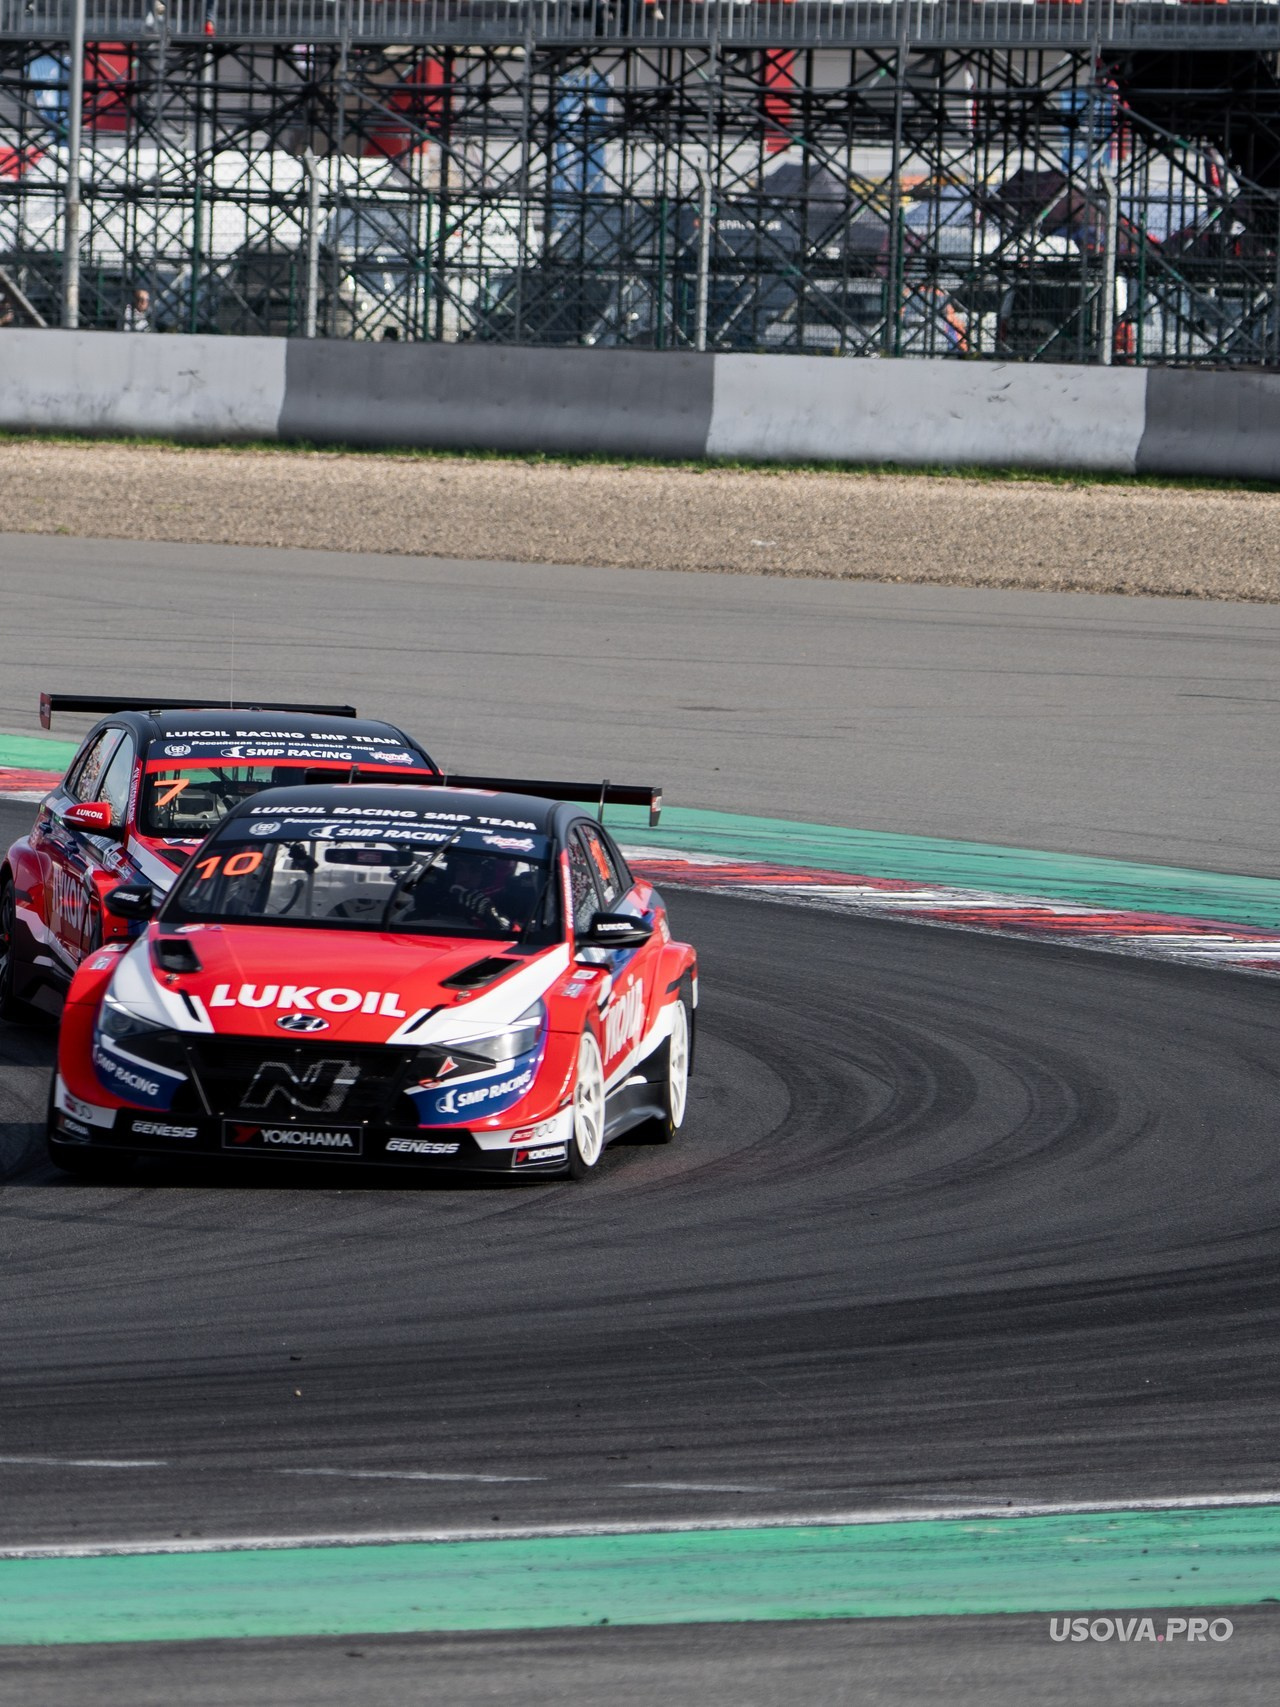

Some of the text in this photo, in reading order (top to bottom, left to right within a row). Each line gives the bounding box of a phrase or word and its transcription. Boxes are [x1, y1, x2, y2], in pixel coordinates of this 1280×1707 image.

[165, 730, 401, 745] LUKOIL RACING SMP TEAM
[246, 748, 352, 760] SMP RACING
[154, 778, 190, 807] 7
[75, 808, 104, 820] LUKOIL
[250, 806, 537, 831] LUKOIL RACING SMP TEAM
[282, 817, 353, 825] Российская
[336, 828, 384, 837] SMP
[196, 852, 264, 880] 10
[209, 983, 406, 1018] LUKOIL
[95, 1053, 160, 1096] SMP RACING
[457, 1069, 532, 1107] SMP RACING
[131, 1122, 199, 1138] GENESIS
[260, 1129, 353, 1148] YOKOHAMA
[385, 1140, 460, 1154] GENESIS
